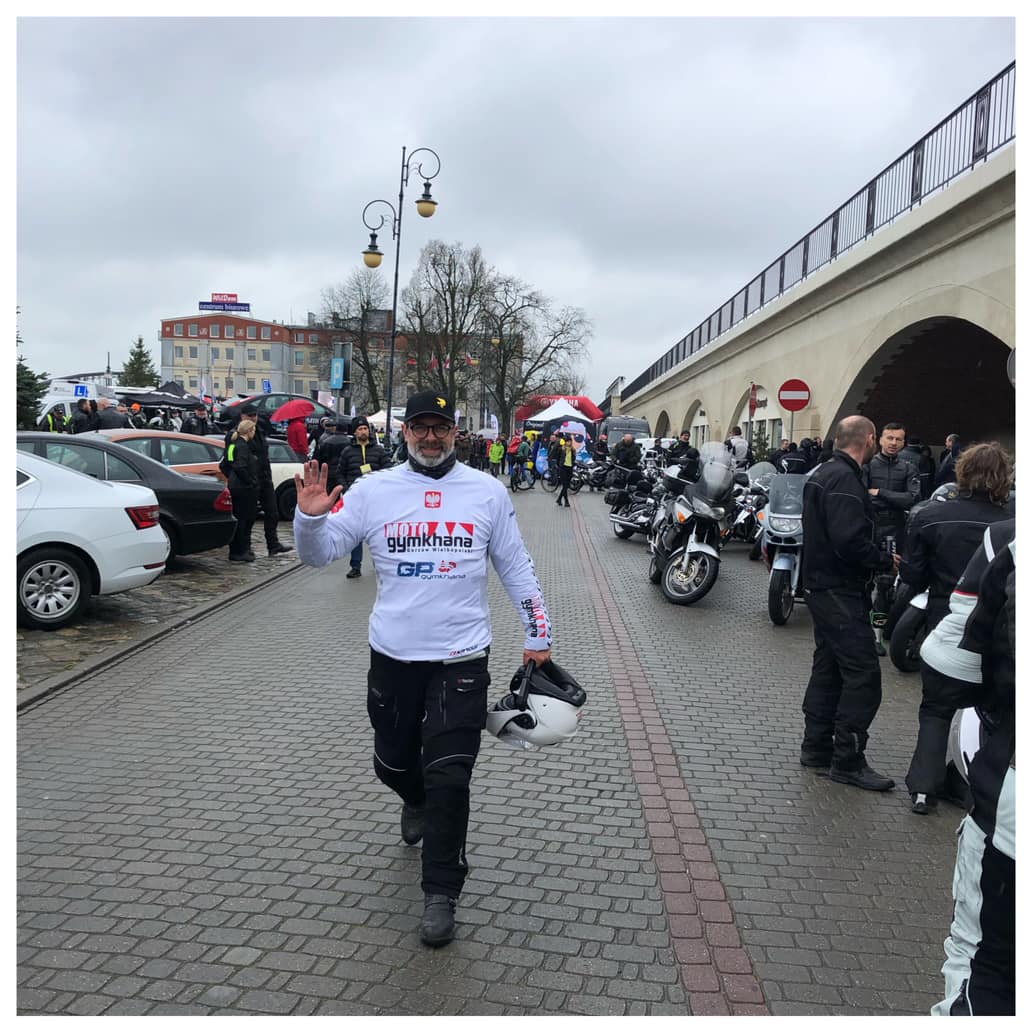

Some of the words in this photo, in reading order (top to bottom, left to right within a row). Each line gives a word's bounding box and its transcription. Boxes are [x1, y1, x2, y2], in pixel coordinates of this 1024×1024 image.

[550, 399, 579, 408] YAHA
[387, 533, 474, 553] gymkhana
[397, 562, 435, 577] GP
